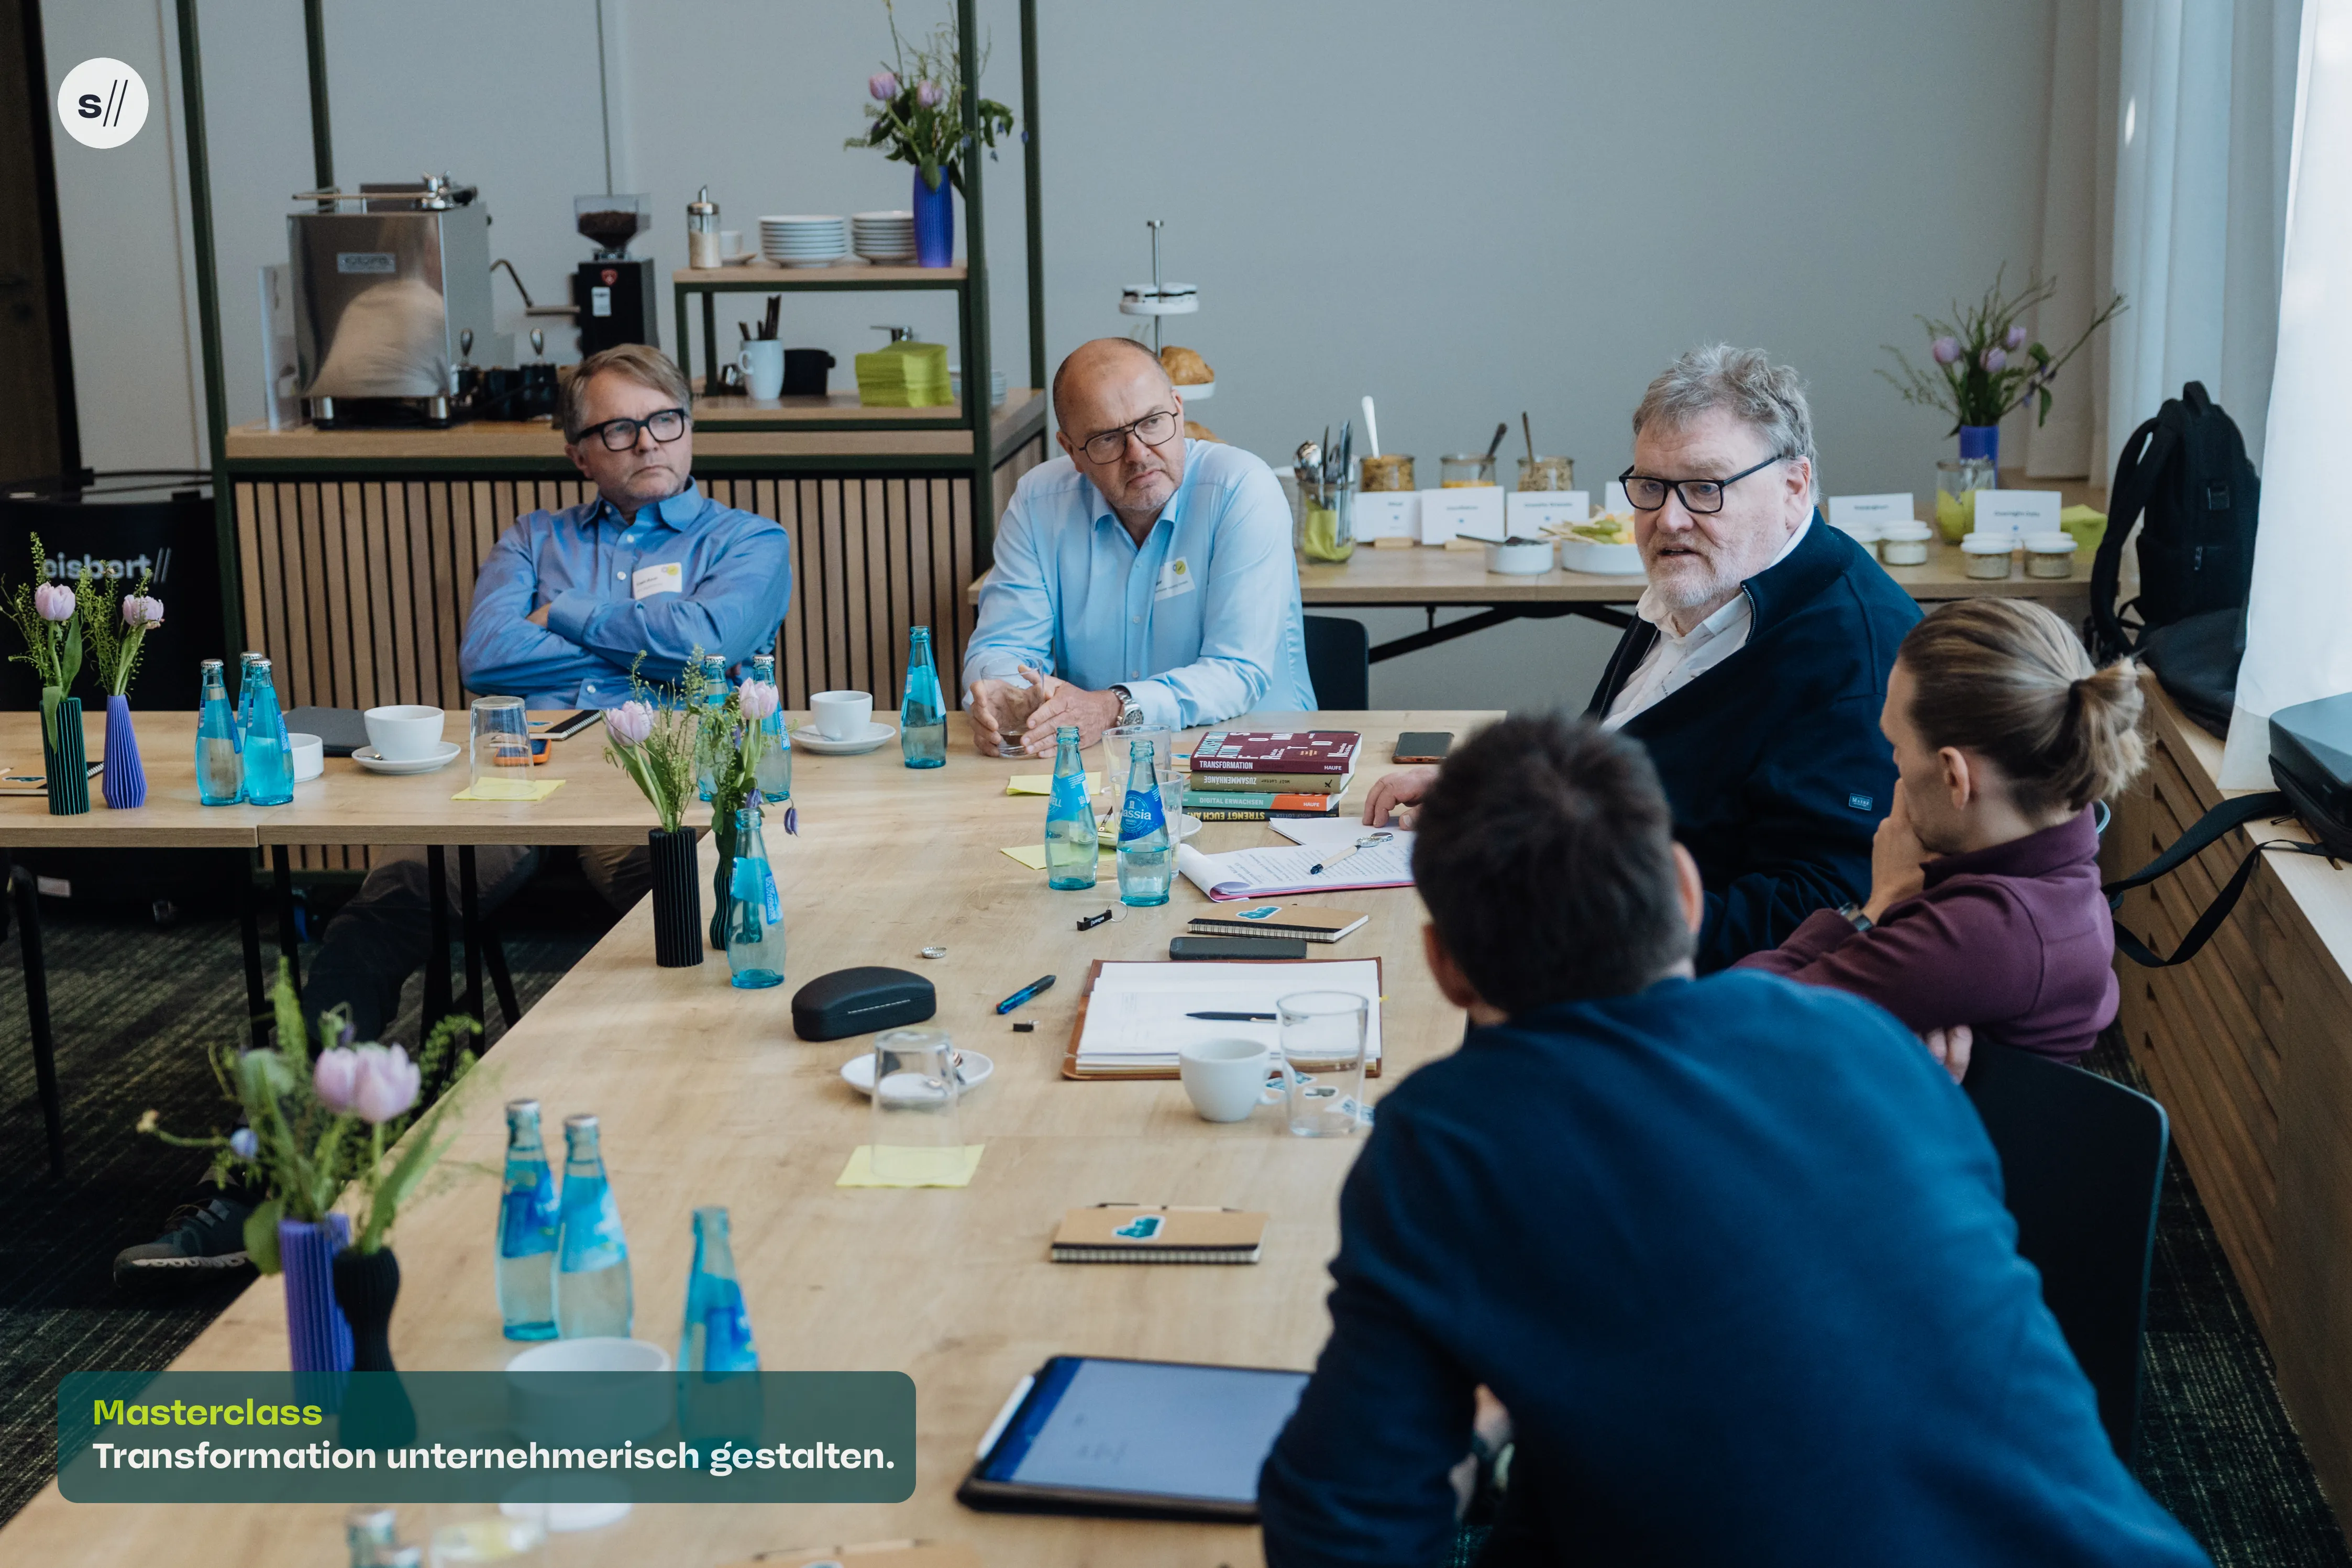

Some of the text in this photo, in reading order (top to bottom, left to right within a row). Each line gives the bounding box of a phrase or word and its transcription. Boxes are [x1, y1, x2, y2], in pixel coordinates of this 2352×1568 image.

[1199, 760, 1253, 769] TRANSFORMATION
[1203, 776, 1257, 785] ZUSAMMENHÄNGE
[1122, 809, 1152, 820] assia
[1203, 812, 1224, 820] EUCH
[1227, 812, 1265, 820] STRENGT
